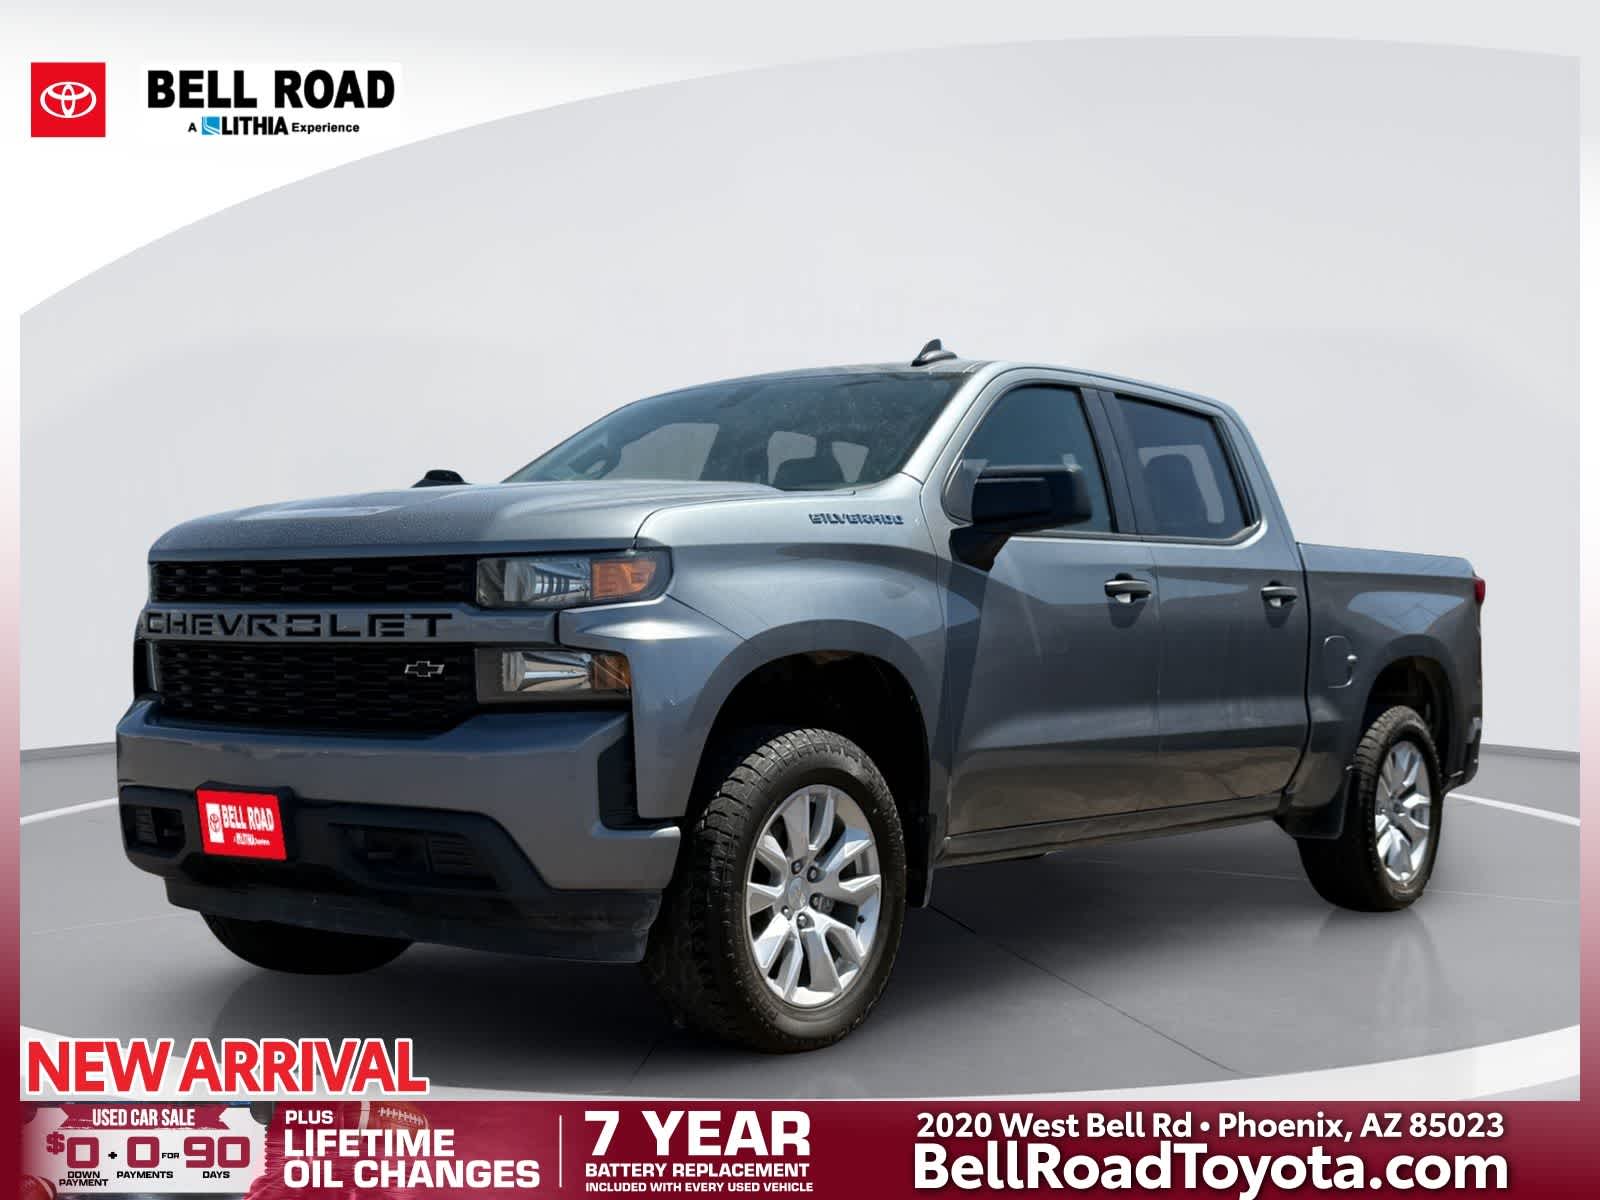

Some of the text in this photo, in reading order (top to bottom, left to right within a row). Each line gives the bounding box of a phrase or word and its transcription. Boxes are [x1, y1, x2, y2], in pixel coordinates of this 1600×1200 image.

[145, 612, 453, 638] CHEVROLET
[221, 804, 275, 833] BELL ROAD
